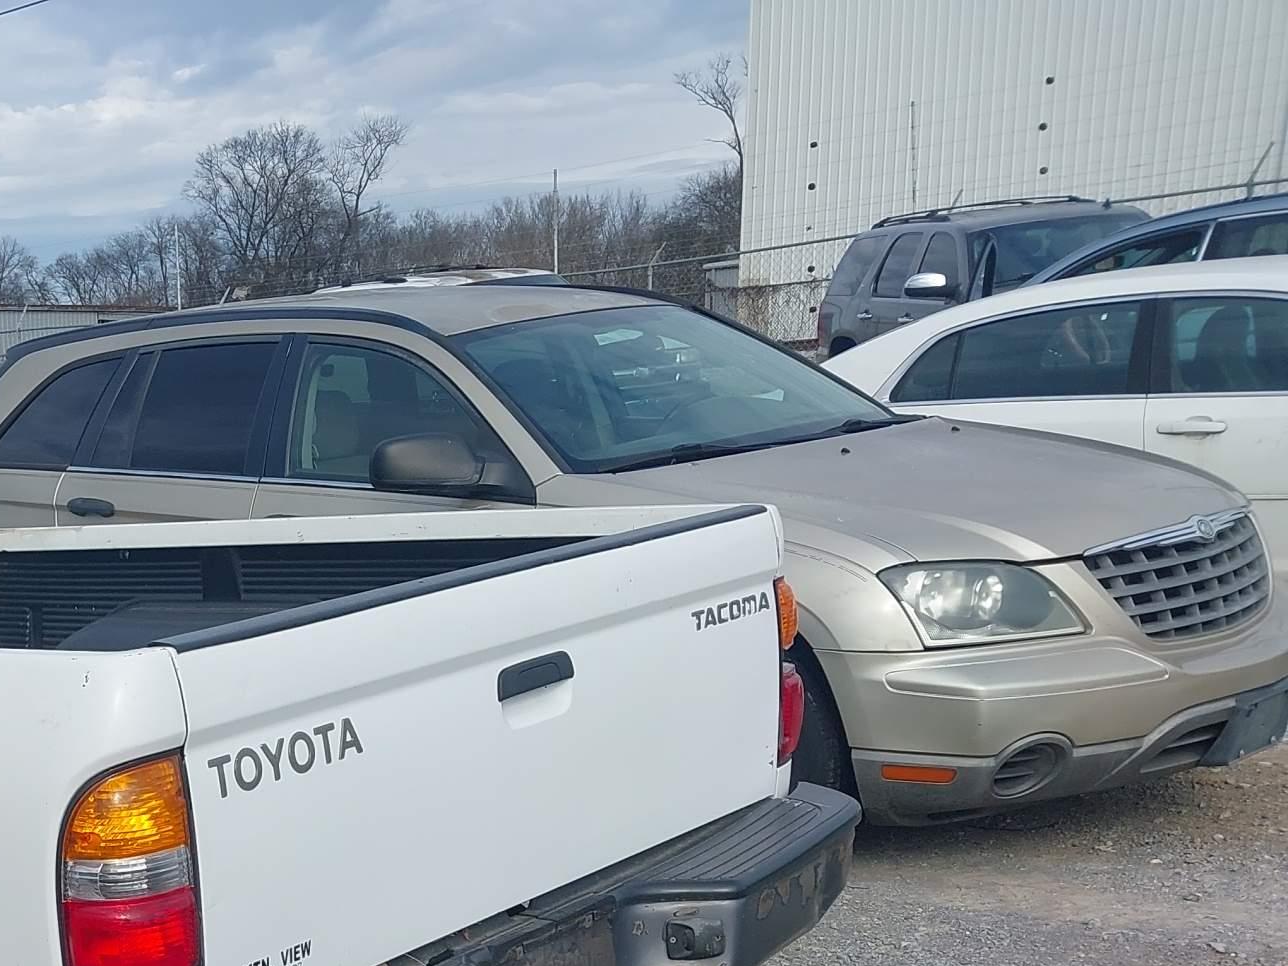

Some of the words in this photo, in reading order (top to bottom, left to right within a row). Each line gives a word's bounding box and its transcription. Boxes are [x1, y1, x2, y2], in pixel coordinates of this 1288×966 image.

[691, 591, 770, 631] TACOMA
[207, 717, 364, 799] TOYOTA
[280, 939, 312, 966] VIEW
